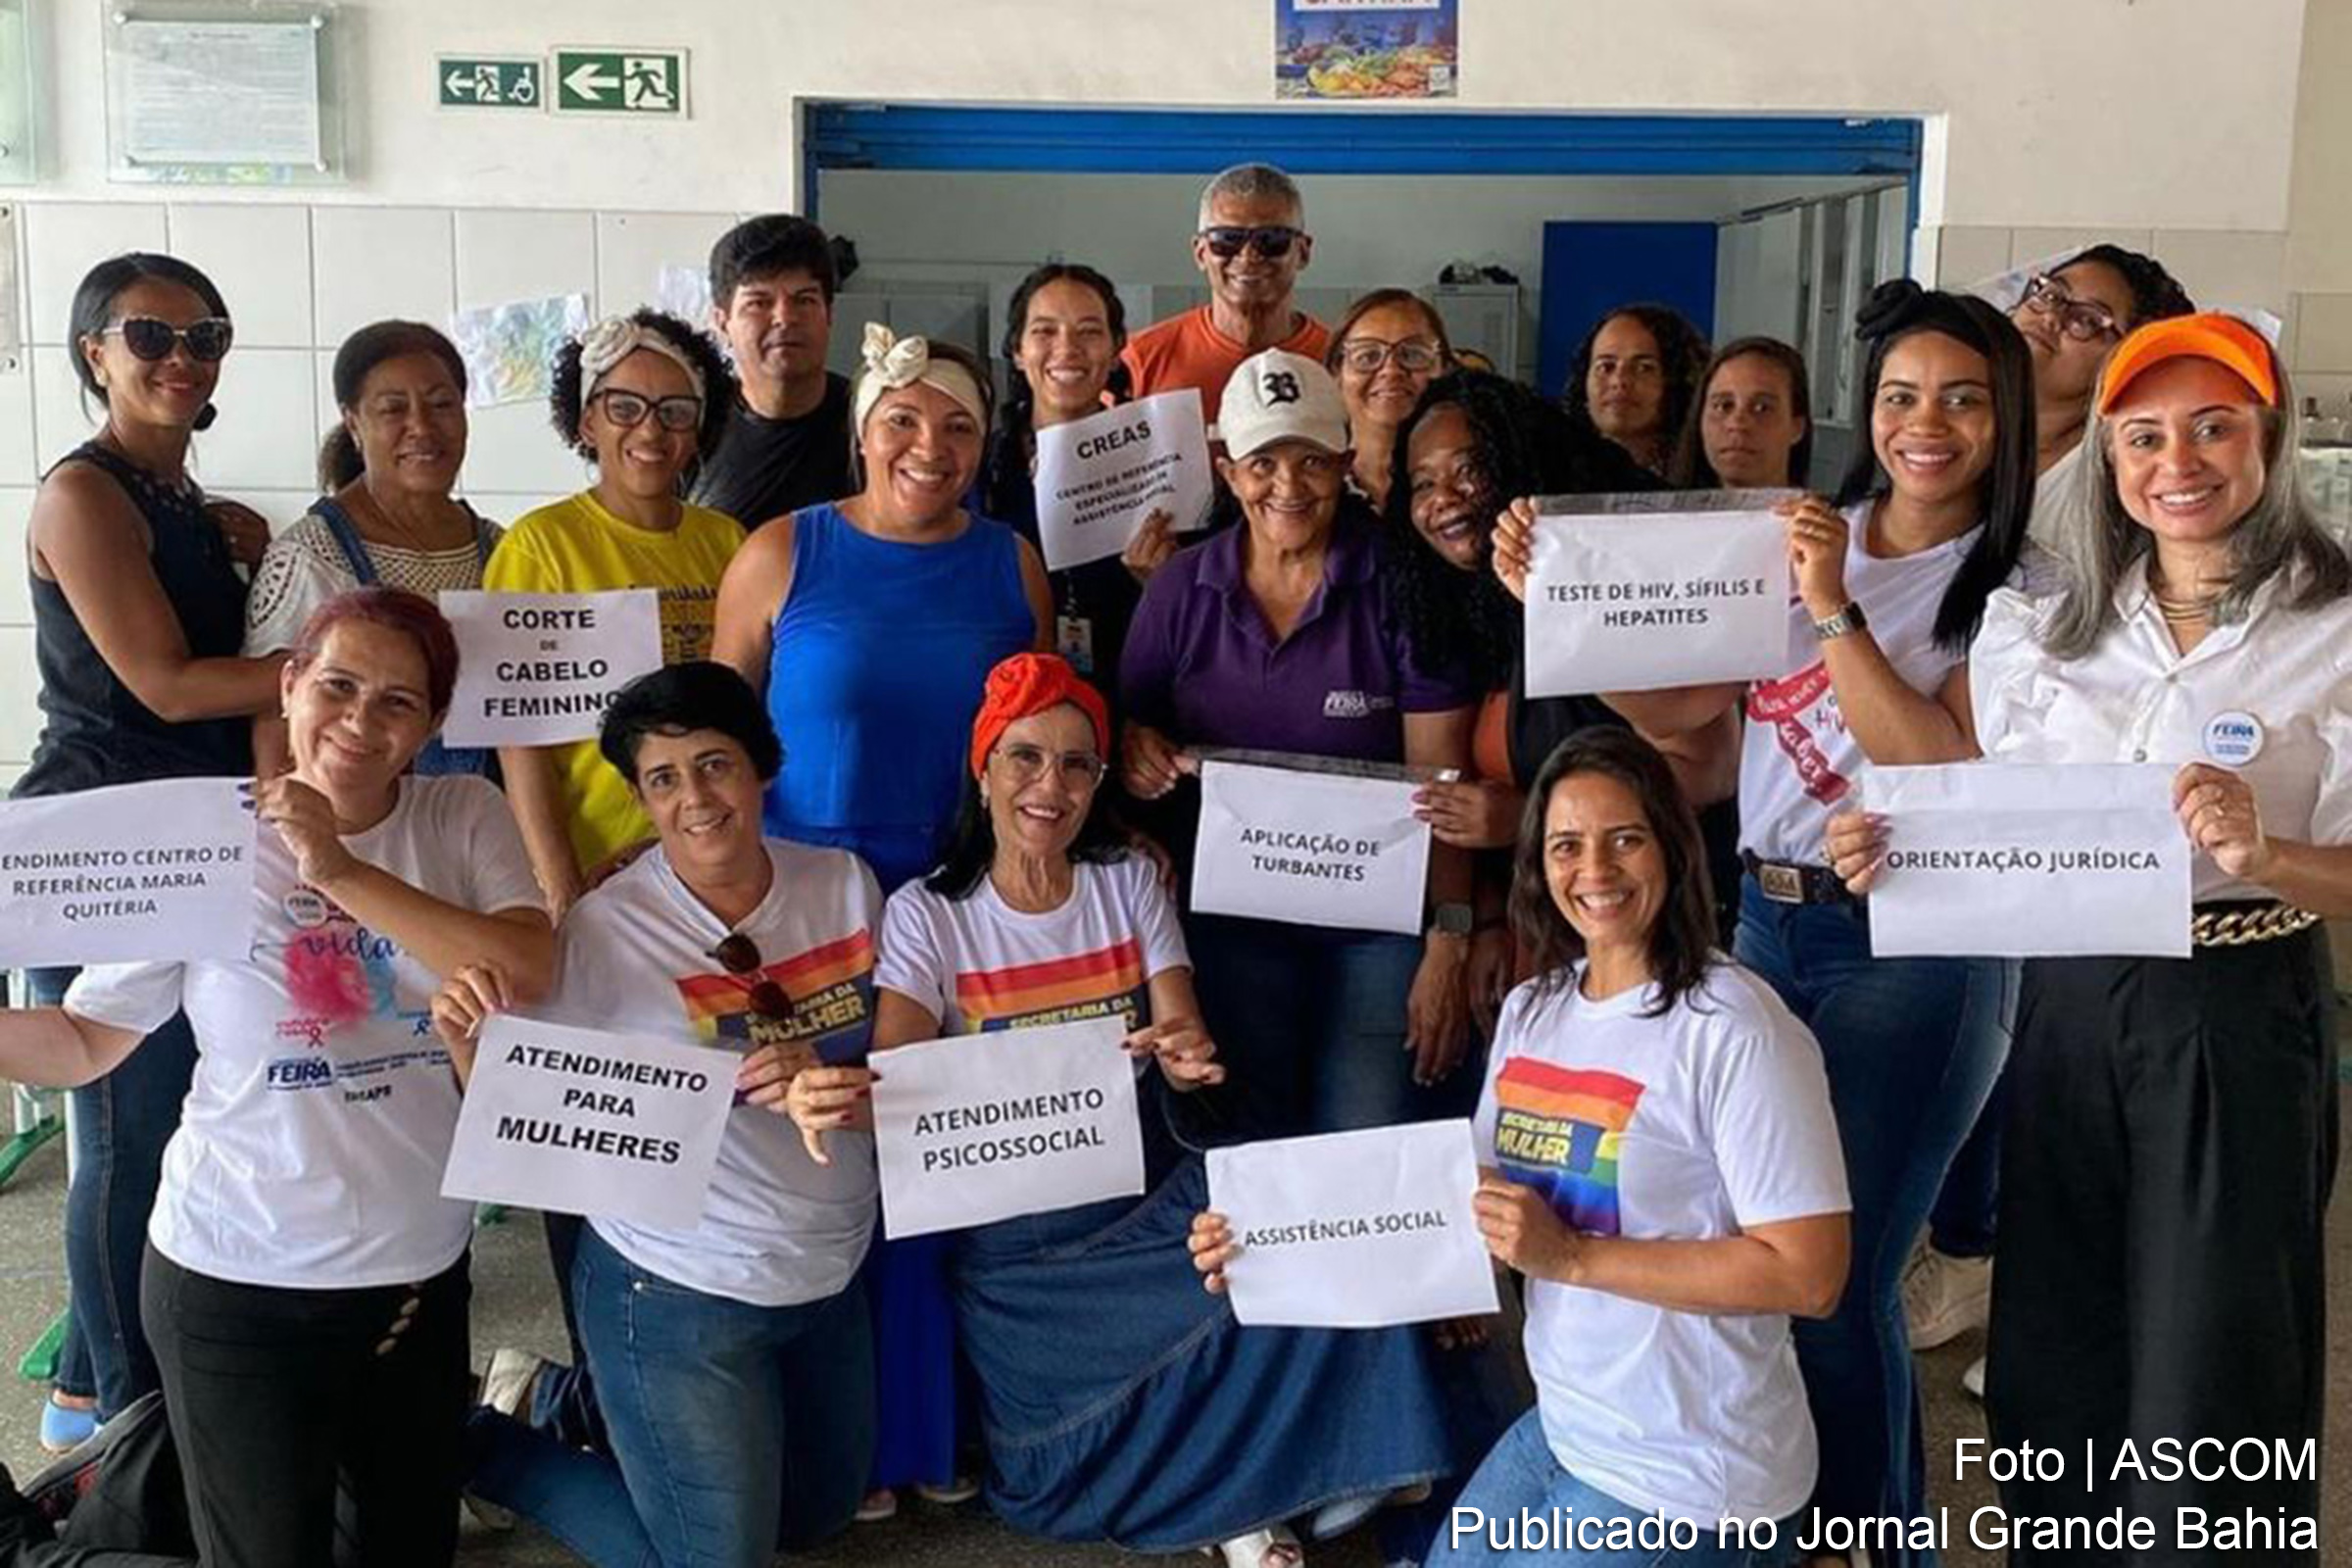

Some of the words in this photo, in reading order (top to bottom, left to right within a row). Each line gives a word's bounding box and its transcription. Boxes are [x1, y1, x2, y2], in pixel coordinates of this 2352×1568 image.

[1077, 419, 1152, 460] CREAS
[1055, 479, 1103, 501] CENTRO
[1105, 473, 1119, 487] DE
[1547, 584, 1601, 602] TESTE
[1608, 584, 1633, 601] DE
[1640, 583, 1679, 601] HIV,
[1686, 577, 1749, 598] SÍFILIS
[1755, 579, 1765, 596] E
[503, 610, 595, 630] CORTE
[1604, 609, 1708, 627] HEPATITES
[540, 640, 559, 652] DE
[497, 660, 608, 682] CABELO
[1241, 828, 1349, 857] APLICAÇÃO
[1356, 840, 1379, 857] DE
[133, 847, 213, 866] CENTRO
[219, 846, 243, 861] DE
[1252, 856, 1365, 881] TURBANTES
[1886, 848, 2041, 873] ORIENTAÇÃO
[2048, 848, 2160, 872] JURÍDICA
[14, 874, 136, 896] REFERÊNCIA
[141, 871, 206, 890] MARIA
[63, 899, 157, 921] QUITÉRIA
[748, 996, 866, 1043] MULHER
[268, 1058, 332, 1083] FEIRA
[507, 1045, 708, 1093] ATENDIMENTO
[564, 1089, 635, 1117] PARA
[914, 1088, 1103, 1136] ATENDIMENTO
[497, 1116, 681, 1164] MULHERES
[923, 1126, 1104, 1171] PSICOSSOCIAL
[1496, 1126, 1571, 1165] MULHER
[1244, 1215, 1370, 1247] ASSISTÊNCIA
[1375, 1210, 1446, 1234] SOCIAL
